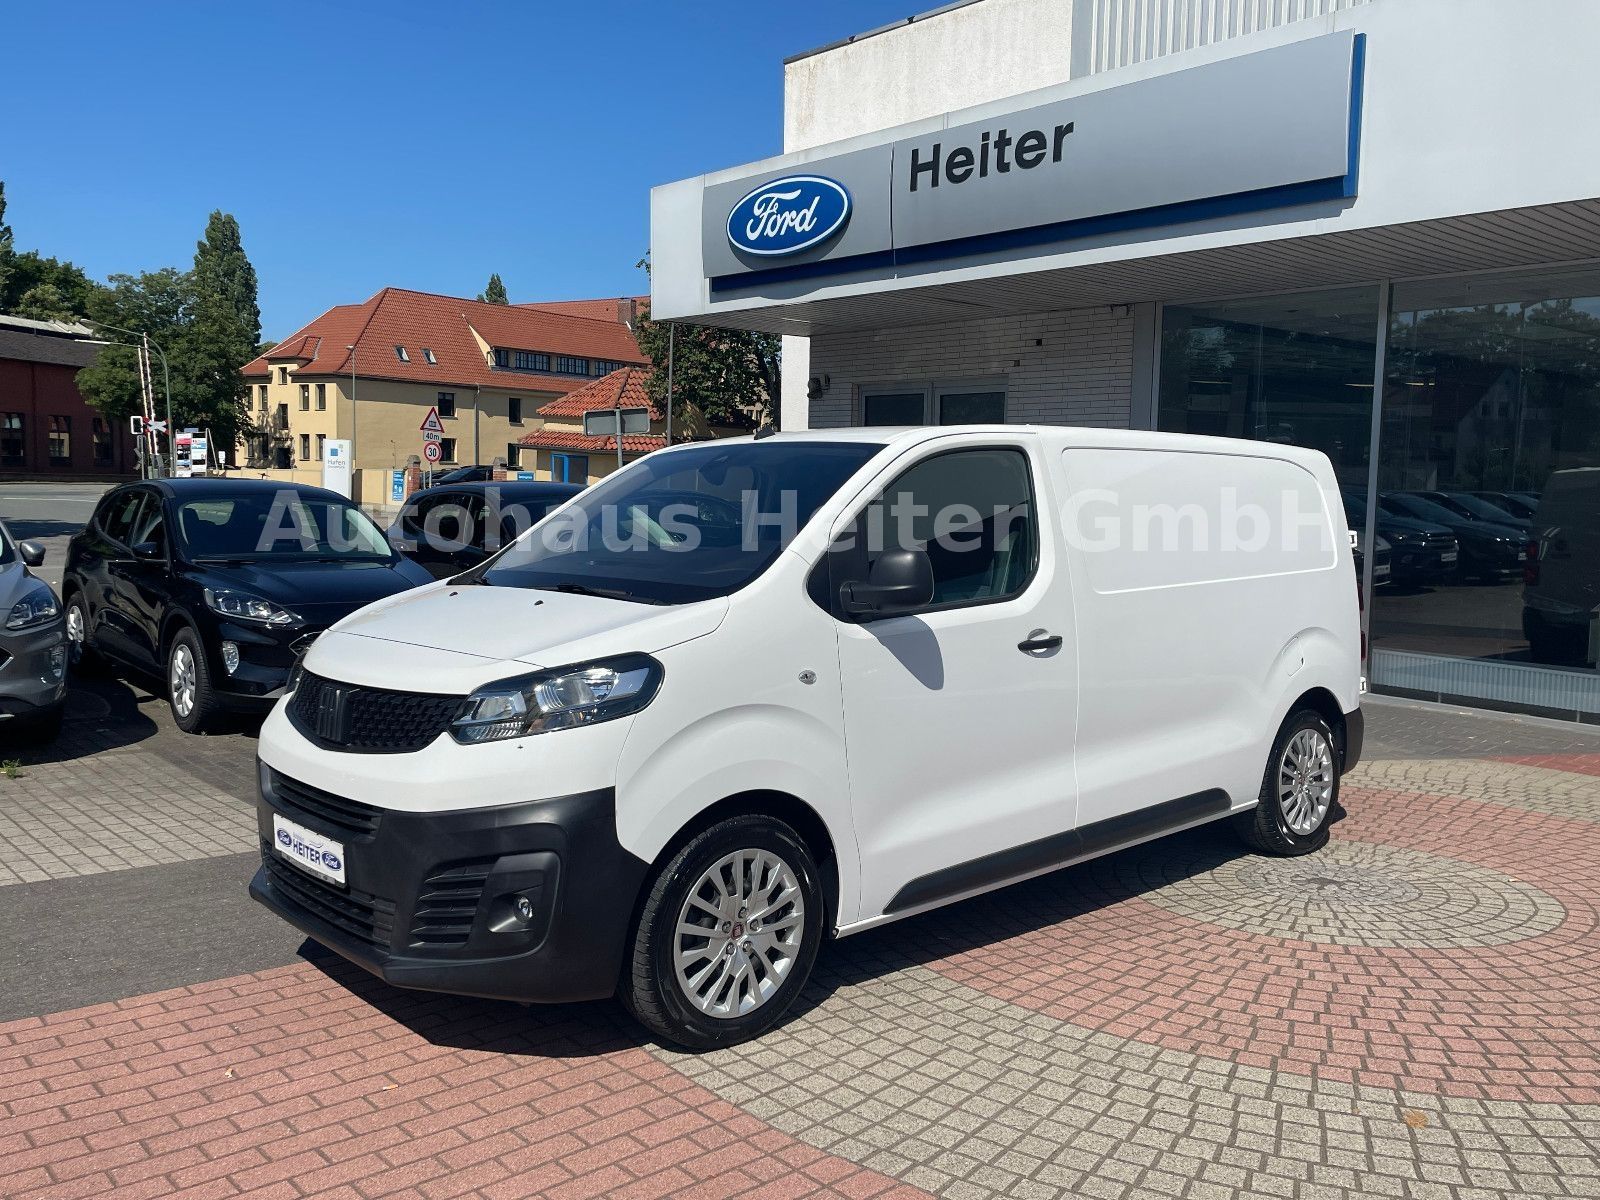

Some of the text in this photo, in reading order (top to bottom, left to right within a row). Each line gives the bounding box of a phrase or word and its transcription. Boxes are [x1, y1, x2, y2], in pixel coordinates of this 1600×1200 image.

[909, 121, 1075, 192] Heiter
[745, 188, 821, 241] Ford
[428, 447, 437, 457] 30
[293, 839, 320, 864] HEITER
